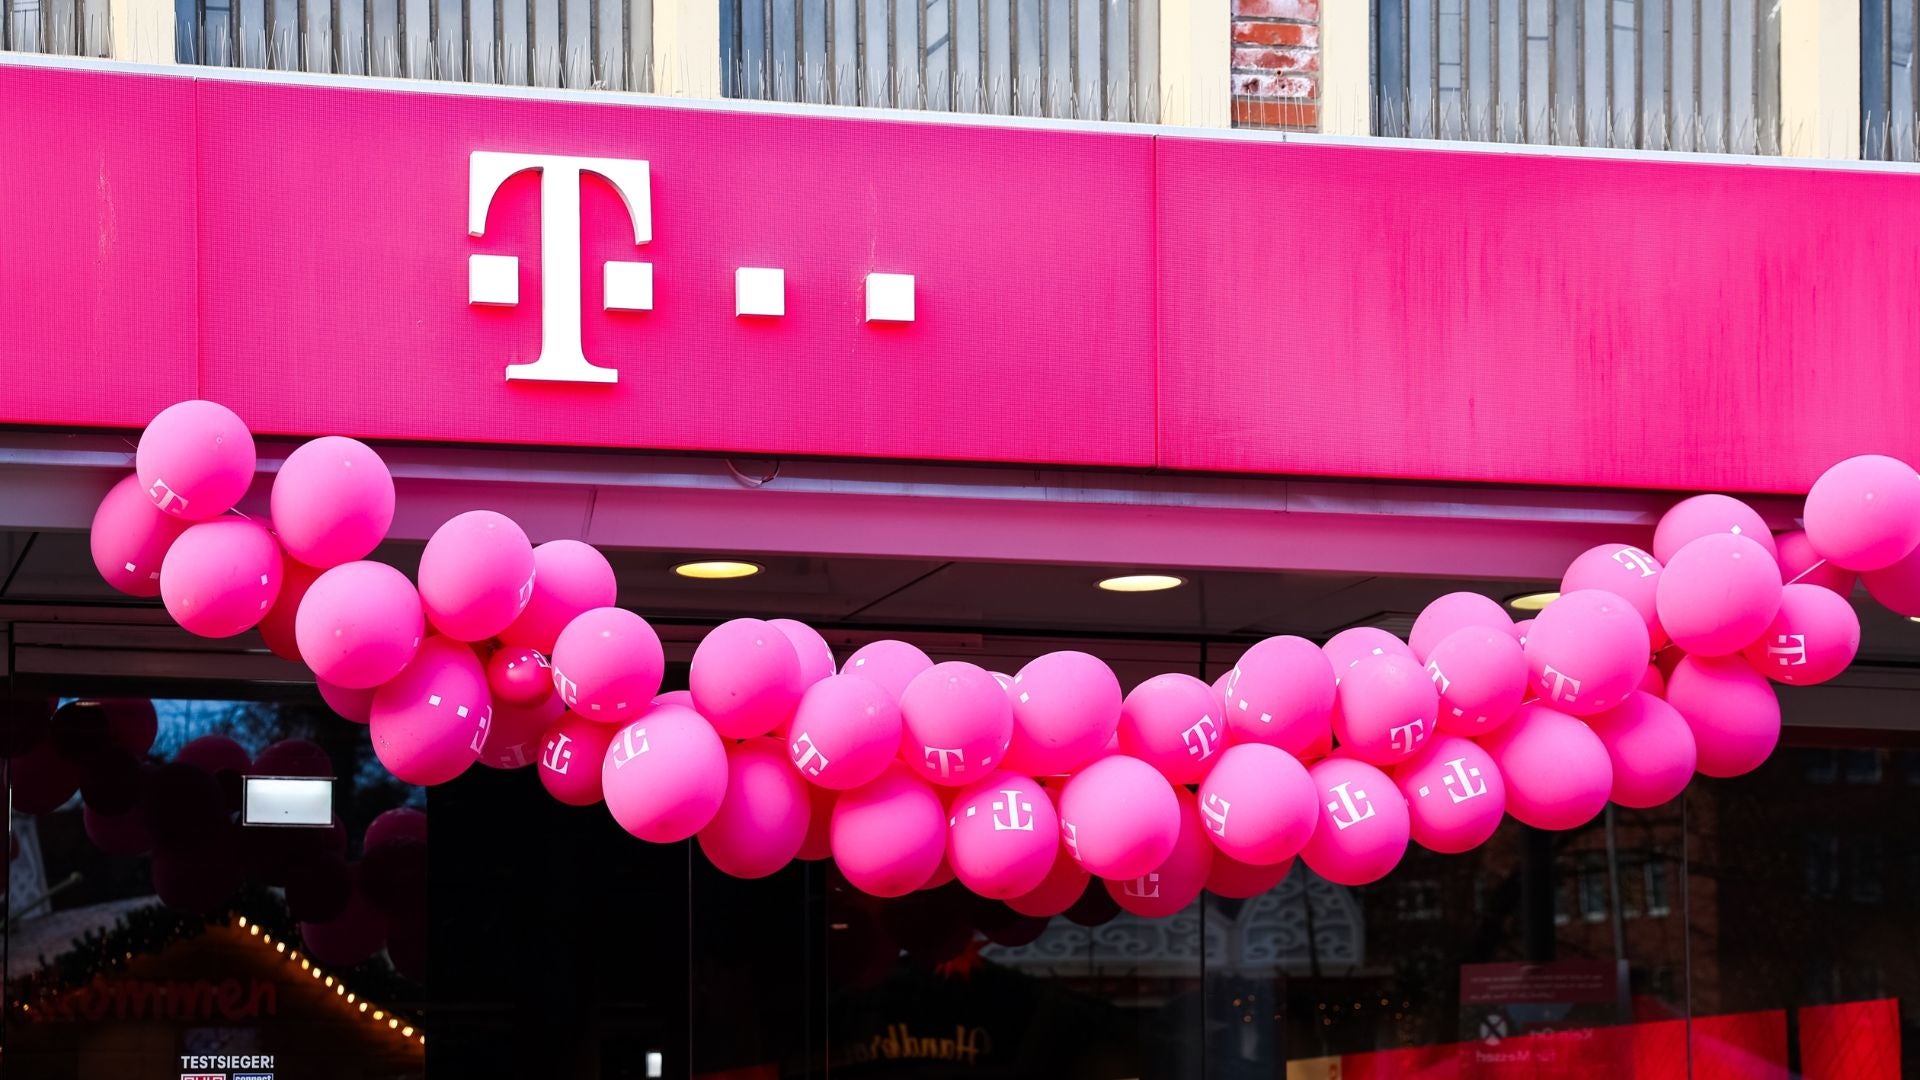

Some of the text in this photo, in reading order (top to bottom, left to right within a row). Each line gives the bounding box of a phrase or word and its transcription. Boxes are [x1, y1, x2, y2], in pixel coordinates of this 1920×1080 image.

[1442, 756, 1488, 804] T
[993, 790, 1034, 832] T
[1327, 781, 1376, 831] T
[181, 1055, 275, 1069] TESTSIEGER!
